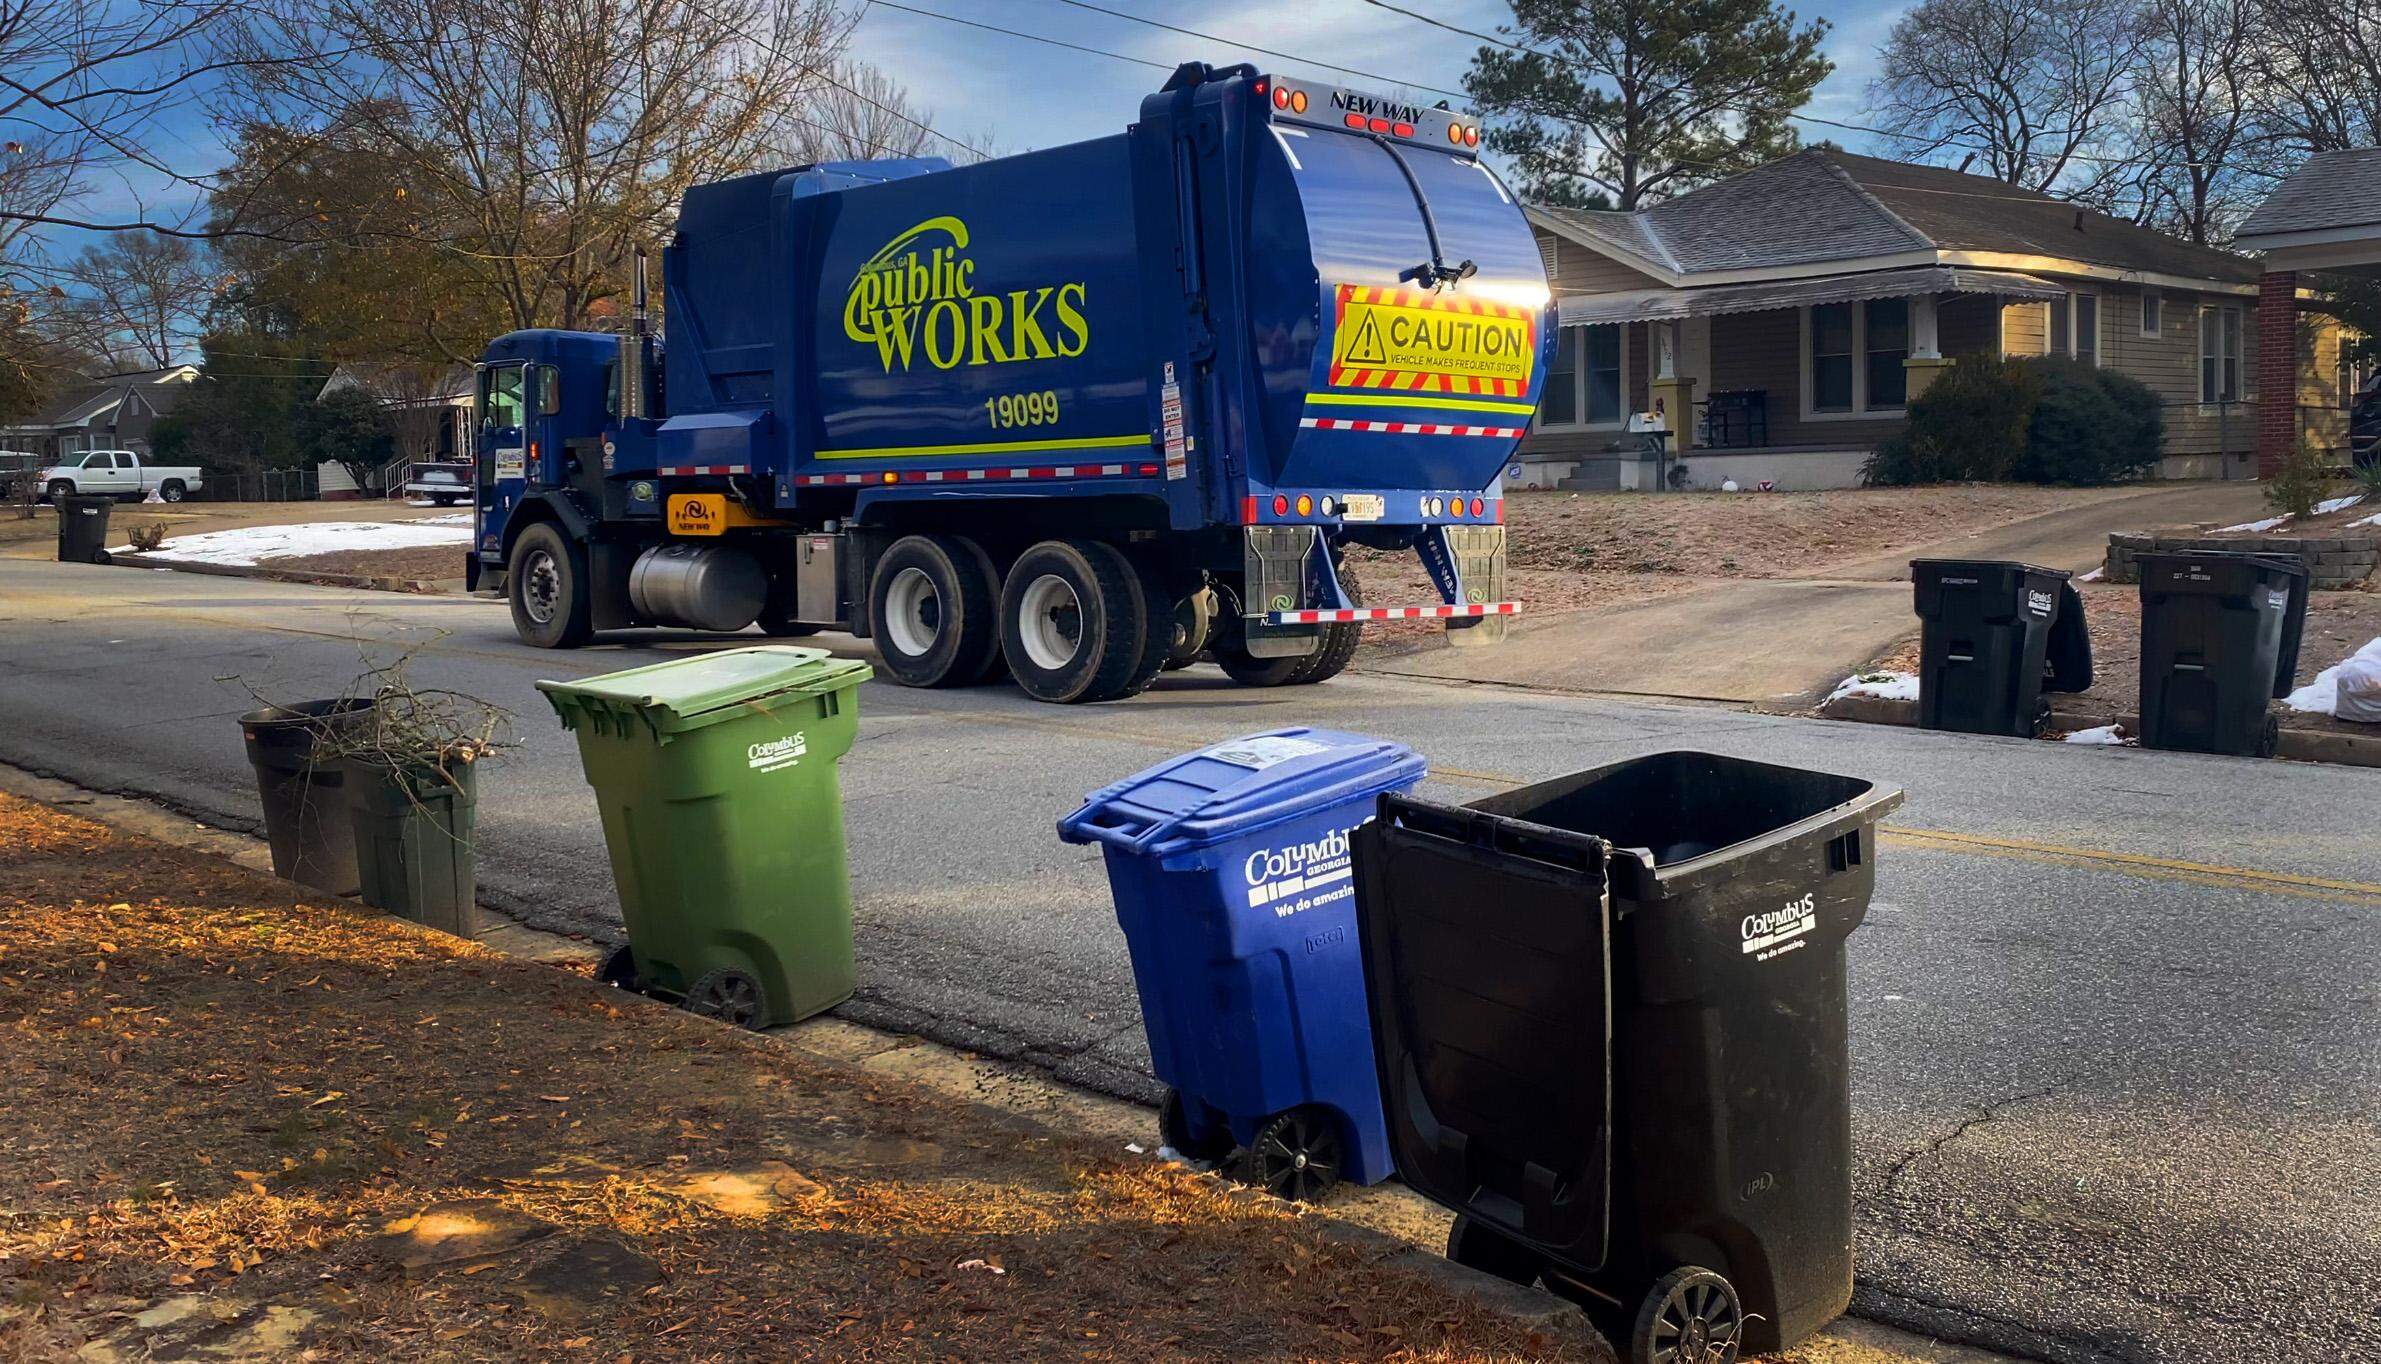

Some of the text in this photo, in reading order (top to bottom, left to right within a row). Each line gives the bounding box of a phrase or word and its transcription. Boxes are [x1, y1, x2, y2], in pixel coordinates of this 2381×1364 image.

[1330, 91, 1425, 124] NEW WAY
[859, 246, 976, 326] public
[869, 281, 1090, 374] WORKS
[1390, 316, 1522, 358] CAUTION
[1390, 354, 1521, 374] VEHICLE MAKES FREQUENT STOPS
[985, 390, 1060, 430] 19099
[1275, 884, 1355, 918] We do amazin
[1757, 953, 1768, 962] We
[1769, 949, 1778, 957] do
